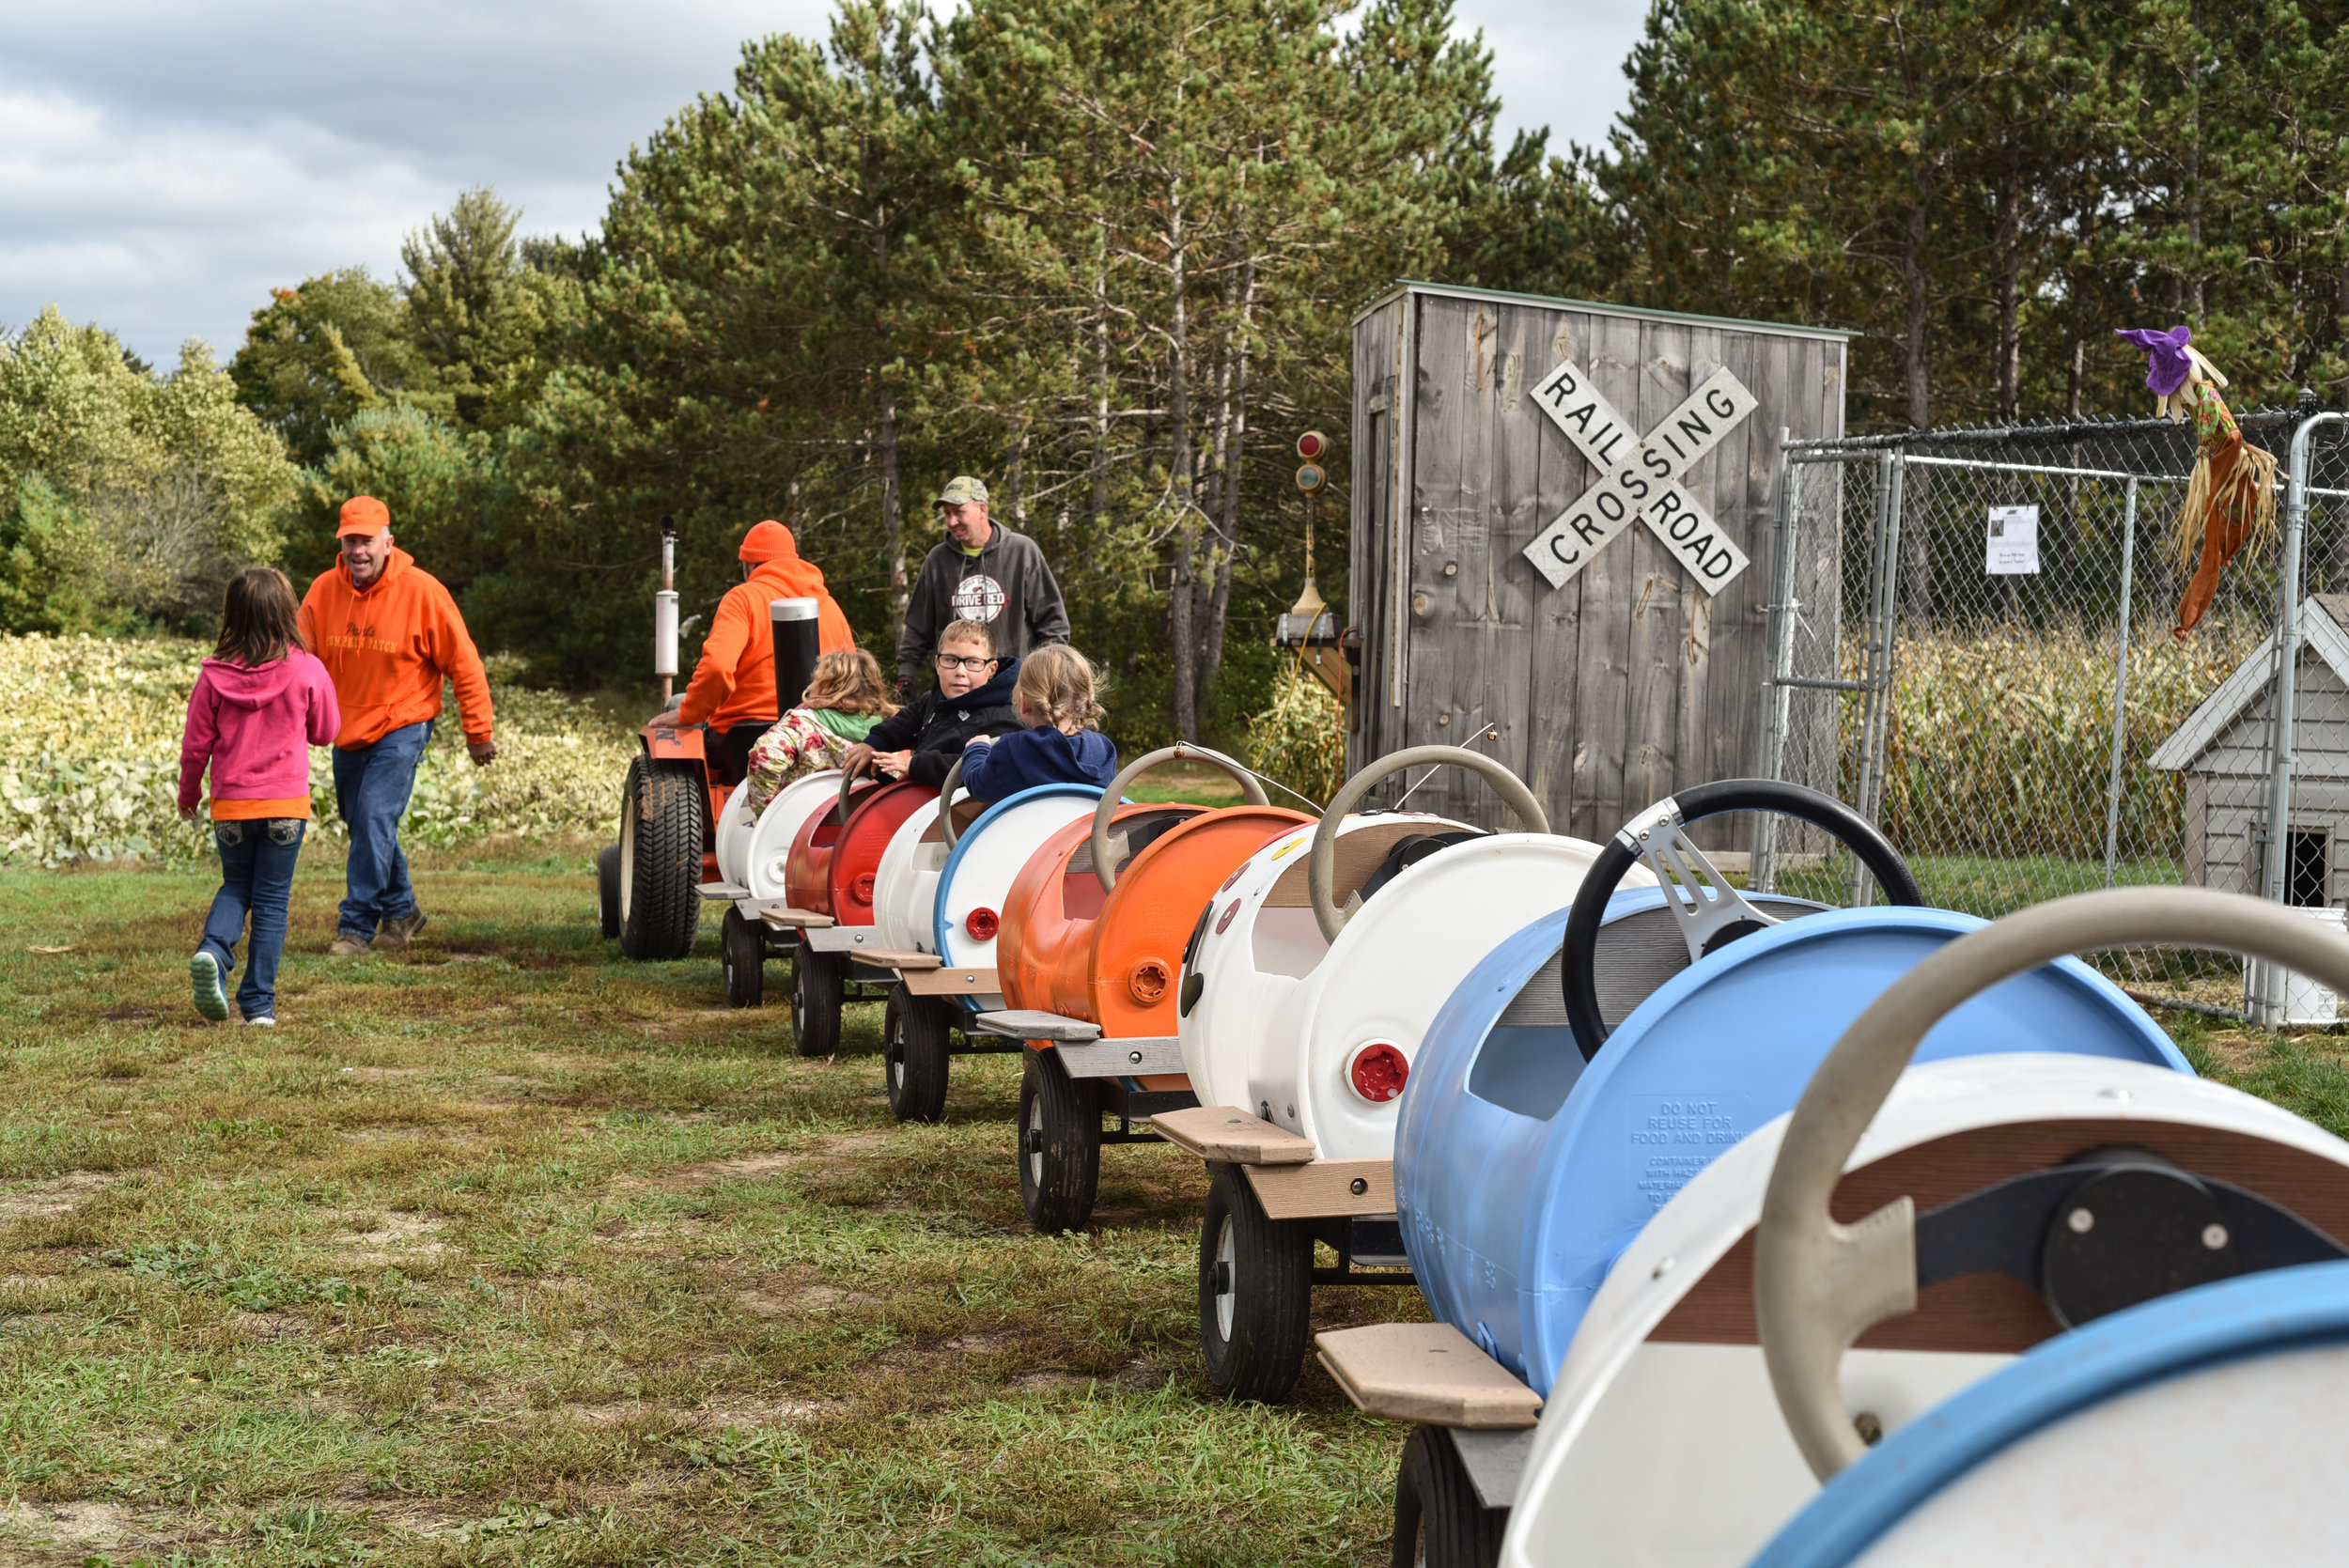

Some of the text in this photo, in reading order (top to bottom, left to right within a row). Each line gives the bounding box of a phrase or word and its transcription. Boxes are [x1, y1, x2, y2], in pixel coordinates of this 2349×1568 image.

[1544, 372, 1733, 579] RAIL ROAD
[1549, 388, 1735, 565] CROSSING
[951, 593, 1005, 607] DRIVE RED
[326, 635, 398, 653] PUMPKIN PATCH
[1660, 1101, 1719, 1116] DO NOT
[1647, 1115, 1734, 1130] REUSE FOR
[1630, 1130, 1670, 1145] FOOD
[1673, 1130, 1703, 1145] AND
[1649, 1155, 1707, 1167] CONTAINER
[1645, 1167, 1670, 1178] WITH
